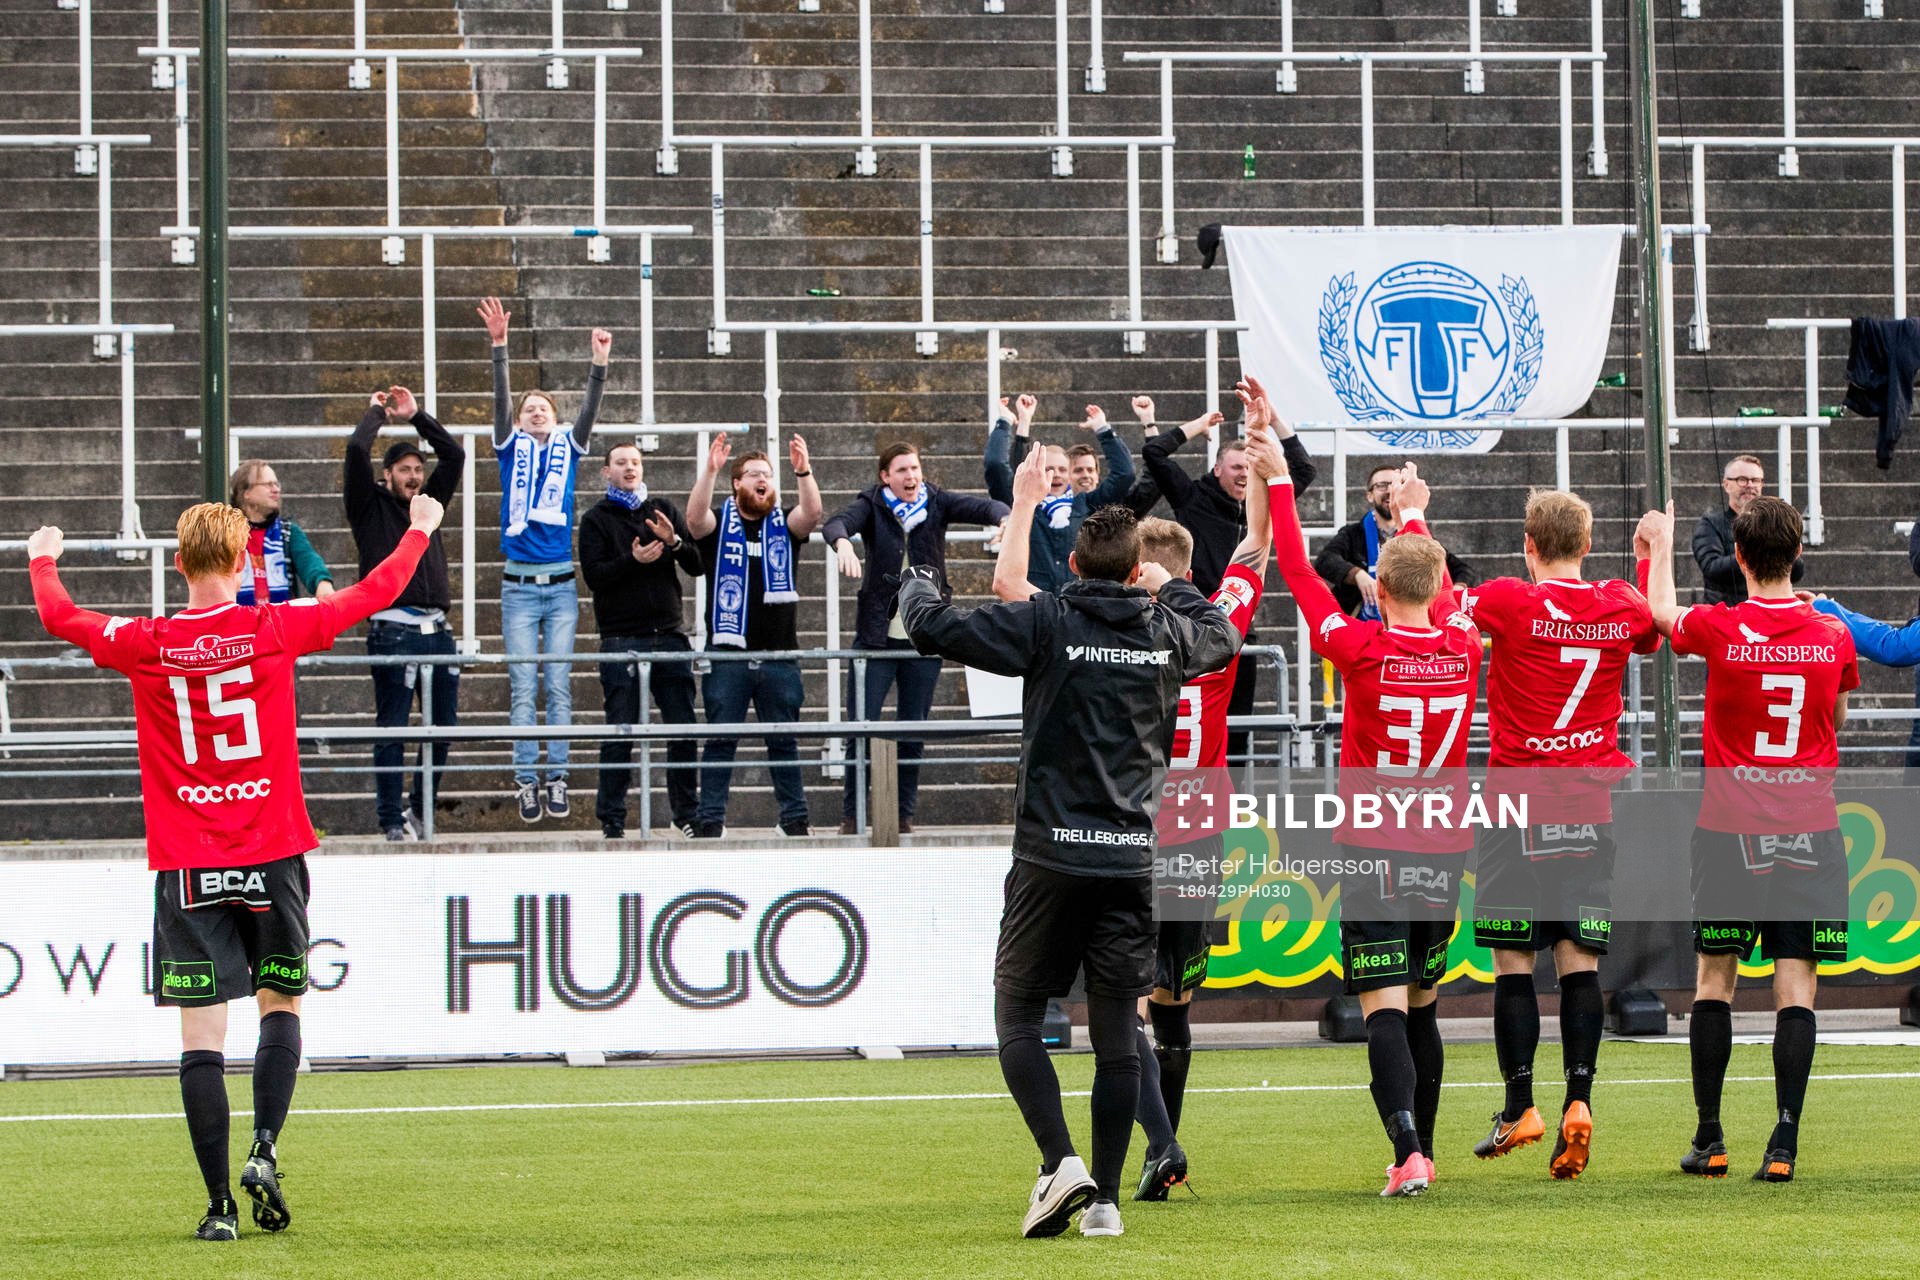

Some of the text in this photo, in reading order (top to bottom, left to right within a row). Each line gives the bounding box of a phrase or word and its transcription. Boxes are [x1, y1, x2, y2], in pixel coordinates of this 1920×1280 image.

[1531, 619, 1631, 641] ERIKSBERG
[1085, 646, 1173, 665] INTERSPORT
[1726, 644, 1836, 663] ERIKSBERG
[1389, 662, 1465, 675] CHEVALIER
[1553, 646, 1602, 730] 7
[168, 665, 263, 765] 15
[1754, 673, 1806, 758] 3
[1376, 693, 1468, 778] 37
[1052, 827, 1148, 846] TRELLEBORGS
[200, 870, 266, 895] BCA
[1399, 867, 1449, 891] BCA
[1475, 914, 1512, 931] akea
[1703, 926, 1740, 940] akea
[446, 888, 869, 1013] HUGO
[1353, 952, 1392, 969] akea
[164, 970, 193, 988] akea
[260, 961, 302, 980] akea
